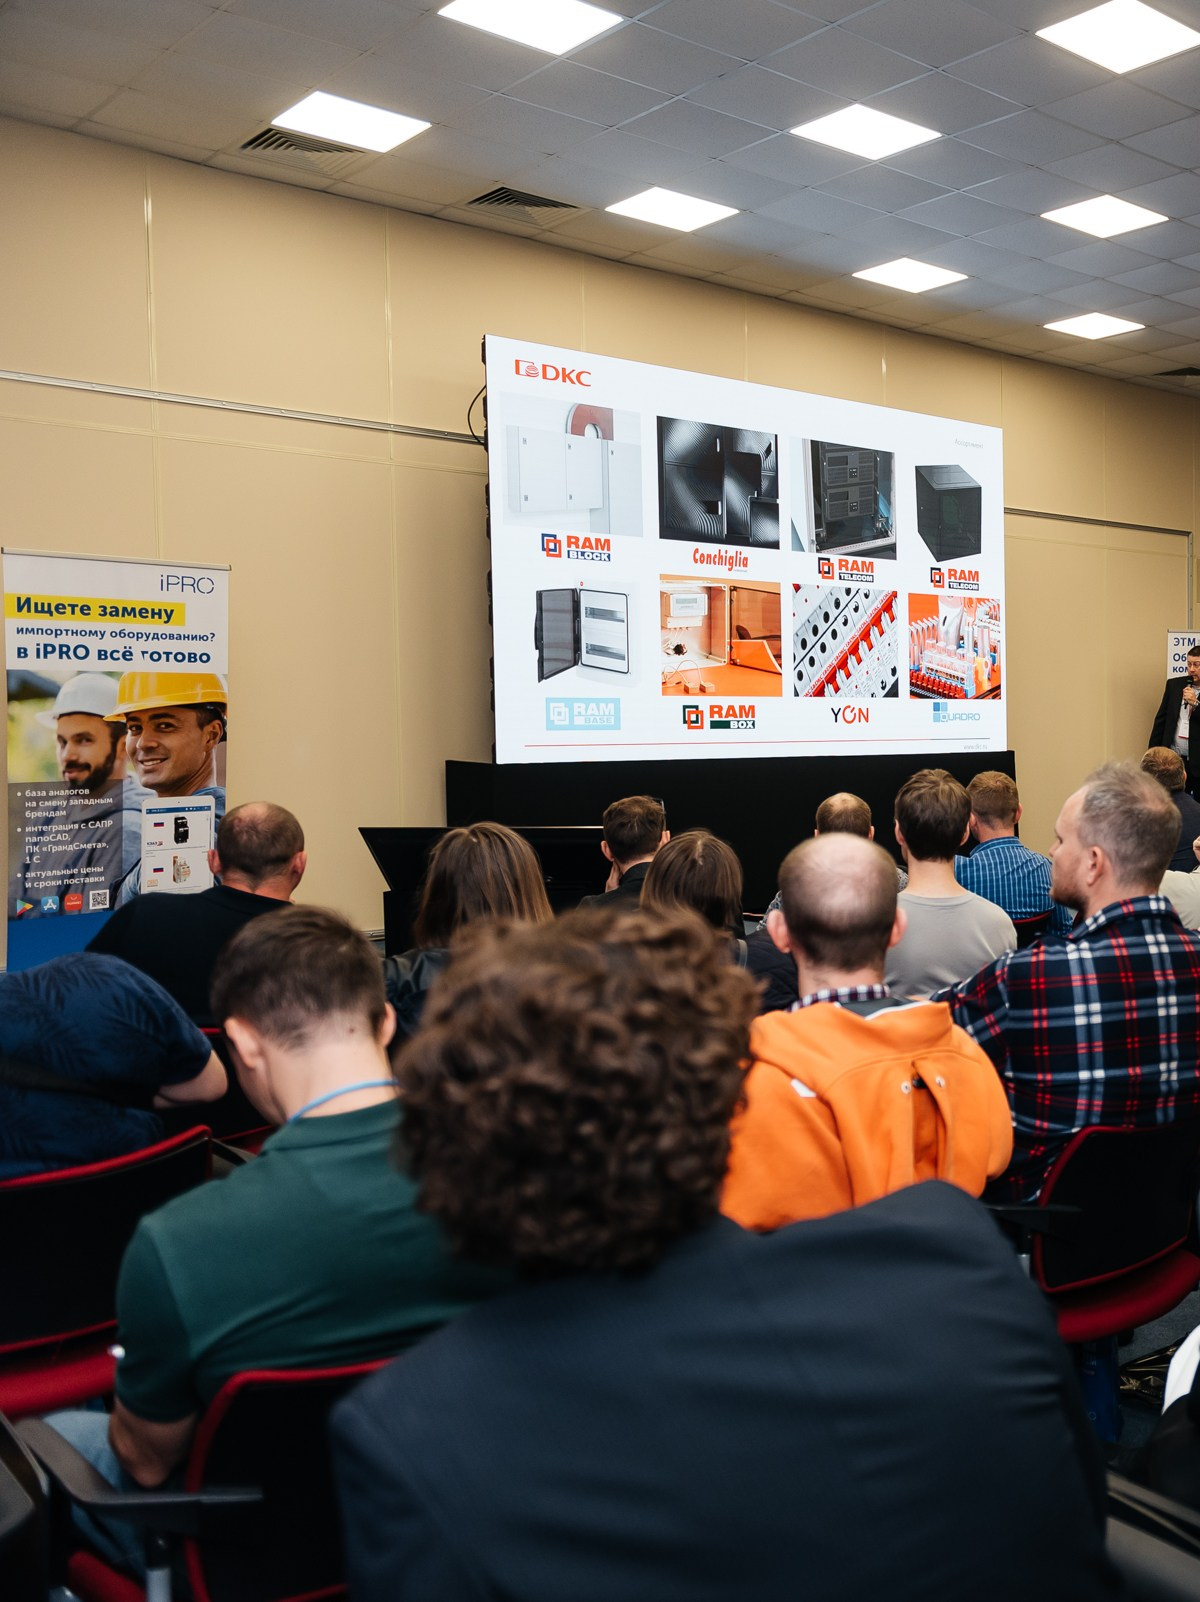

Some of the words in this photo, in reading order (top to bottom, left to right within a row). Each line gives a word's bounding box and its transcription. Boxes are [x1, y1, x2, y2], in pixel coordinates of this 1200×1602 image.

[541, 363, 592, 387] DKC
[566, 535, 611, 552] RAM
[569, 551, 611, 562] BLOCK
[693, 548, 749, 571] Conchiglia
[838, 558, 875, 574] RAM
[838, 573, 874, 583] TELECOM
[947, 568, 980, 583] RAM
[160, 574, 215, 595] iPRO
[948, 582, 979, 591] TELECOM
[16, 597, 92, 618] Ищете
[97, 603, 175, 624] замену
[16, 626, 106, 641] импортному
[109, 629, 216, 643] оборудованию?
[1173, 638, 1196, 647] ЭТМ
[16, 646, 29, 659] в
[35, 643, 90, 661] iPRO
[97, 646, 134, 662] всё
[573, 702, 615, 716] RAM
[708, 705, 755, 719] RAM
[730, 719, 755, 729] BOX
[25, 789, 47, 797] база
[48, 788, 90, 797] аналогов
[25, 800, 37, 808] на
[39, 799, 68, 809] смену
[69, 797, 113, 806] западным
[25, 809, 67, 819] брендам
[25, 822, 79, 833] интеграция
[88, 820, 114, 829] САПР
[25, 846, 40, 854] ПК
[25, 868, 79, 879] актуальные
[80, 866, 104, 874] цены
[33, 879, 62, 889] сроки
[63, 875, 105, 886] поставки
